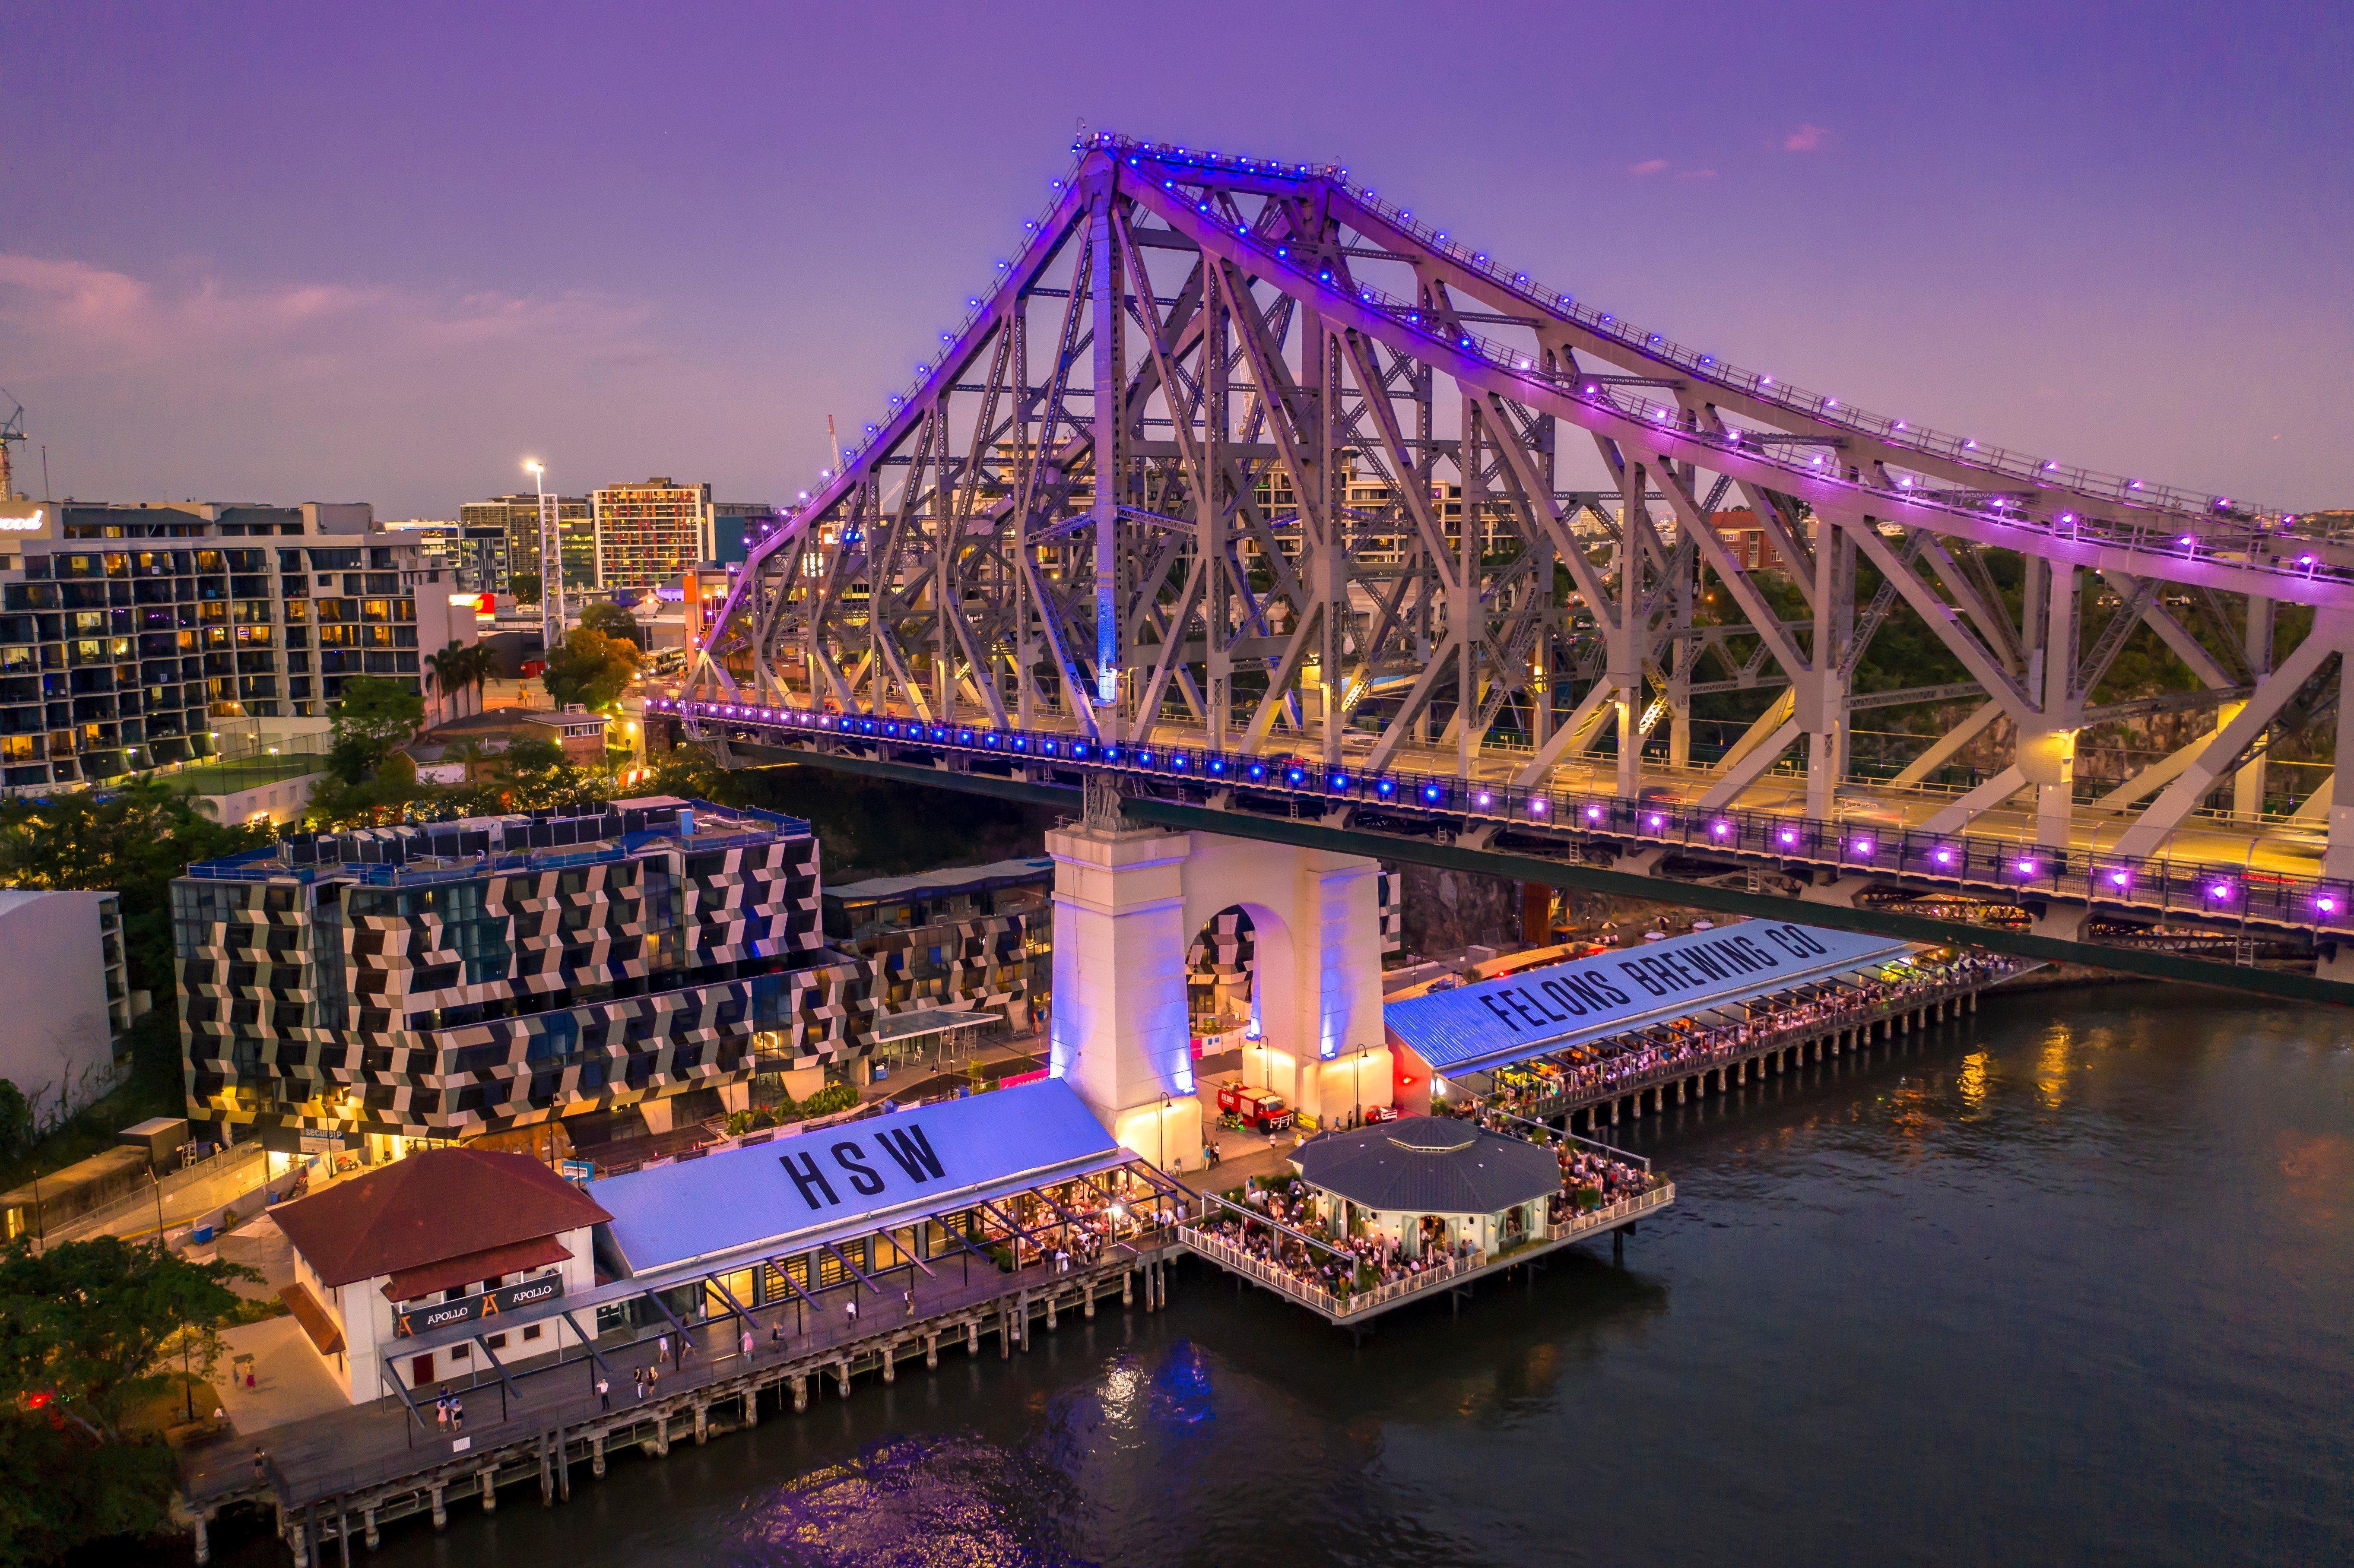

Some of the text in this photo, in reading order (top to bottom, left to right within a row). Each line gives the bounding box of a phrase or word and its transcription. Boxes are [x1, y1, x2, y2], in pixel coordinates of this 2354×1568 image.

[0, 510, 43, 530] ood
[1479, 970, 1631, 1032] FELONS
[1618, 936, 1778, 996] BREWING
[778, 1124, 945, 1210] HSW
[513, 1286, 552, 1302] APOLLO
[427, 1307, 468, 1325] APOLLO
